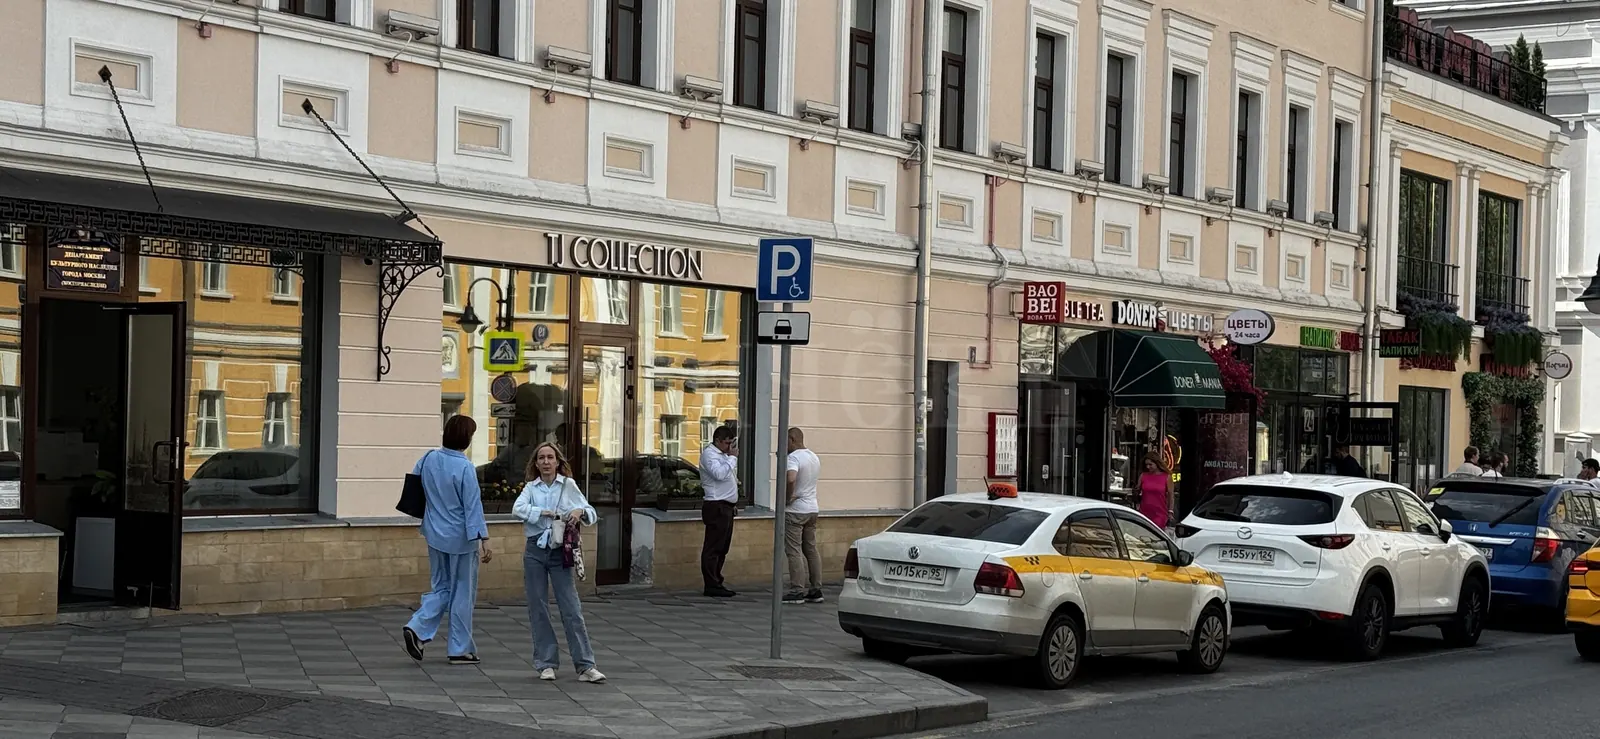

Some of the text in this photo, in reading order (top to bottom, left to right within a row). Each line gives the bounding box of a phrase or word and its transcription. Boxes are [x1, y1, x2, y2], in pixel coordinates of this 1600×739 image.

[64, 251, 104, 260] ДЕПАРТАМЕНТ
[544, 232, 704, 280] TJ COLLECTION
[50, 259, 88, 269] КУЛЬТУРНОГО
[771, 245, 801, 295] P
[62, 270, 82, 278] ГОРОДА
[1027, 284, 1058, 297] BAO
[1027, 298, 1057, 313] BEI
[1085, 302, 1106, 321] TEA
[1171, 311, 1213, 332] ЦВЕТЫ
[1227, 319, 1268, 330] ЦВЕТЫ
[1303, 327, 1334, 349] НАПИТКИ
[1381, 331, 1420, 344] ТАБАК
[1380, 345, 1419, 356] НАПИТКИ
[1202, 377, 1223, 390] MANIA
[1258, 550, 1273, 560] 124
[888, 564, 928, 579] М015КР
[930, 568, 941, 577] 95
